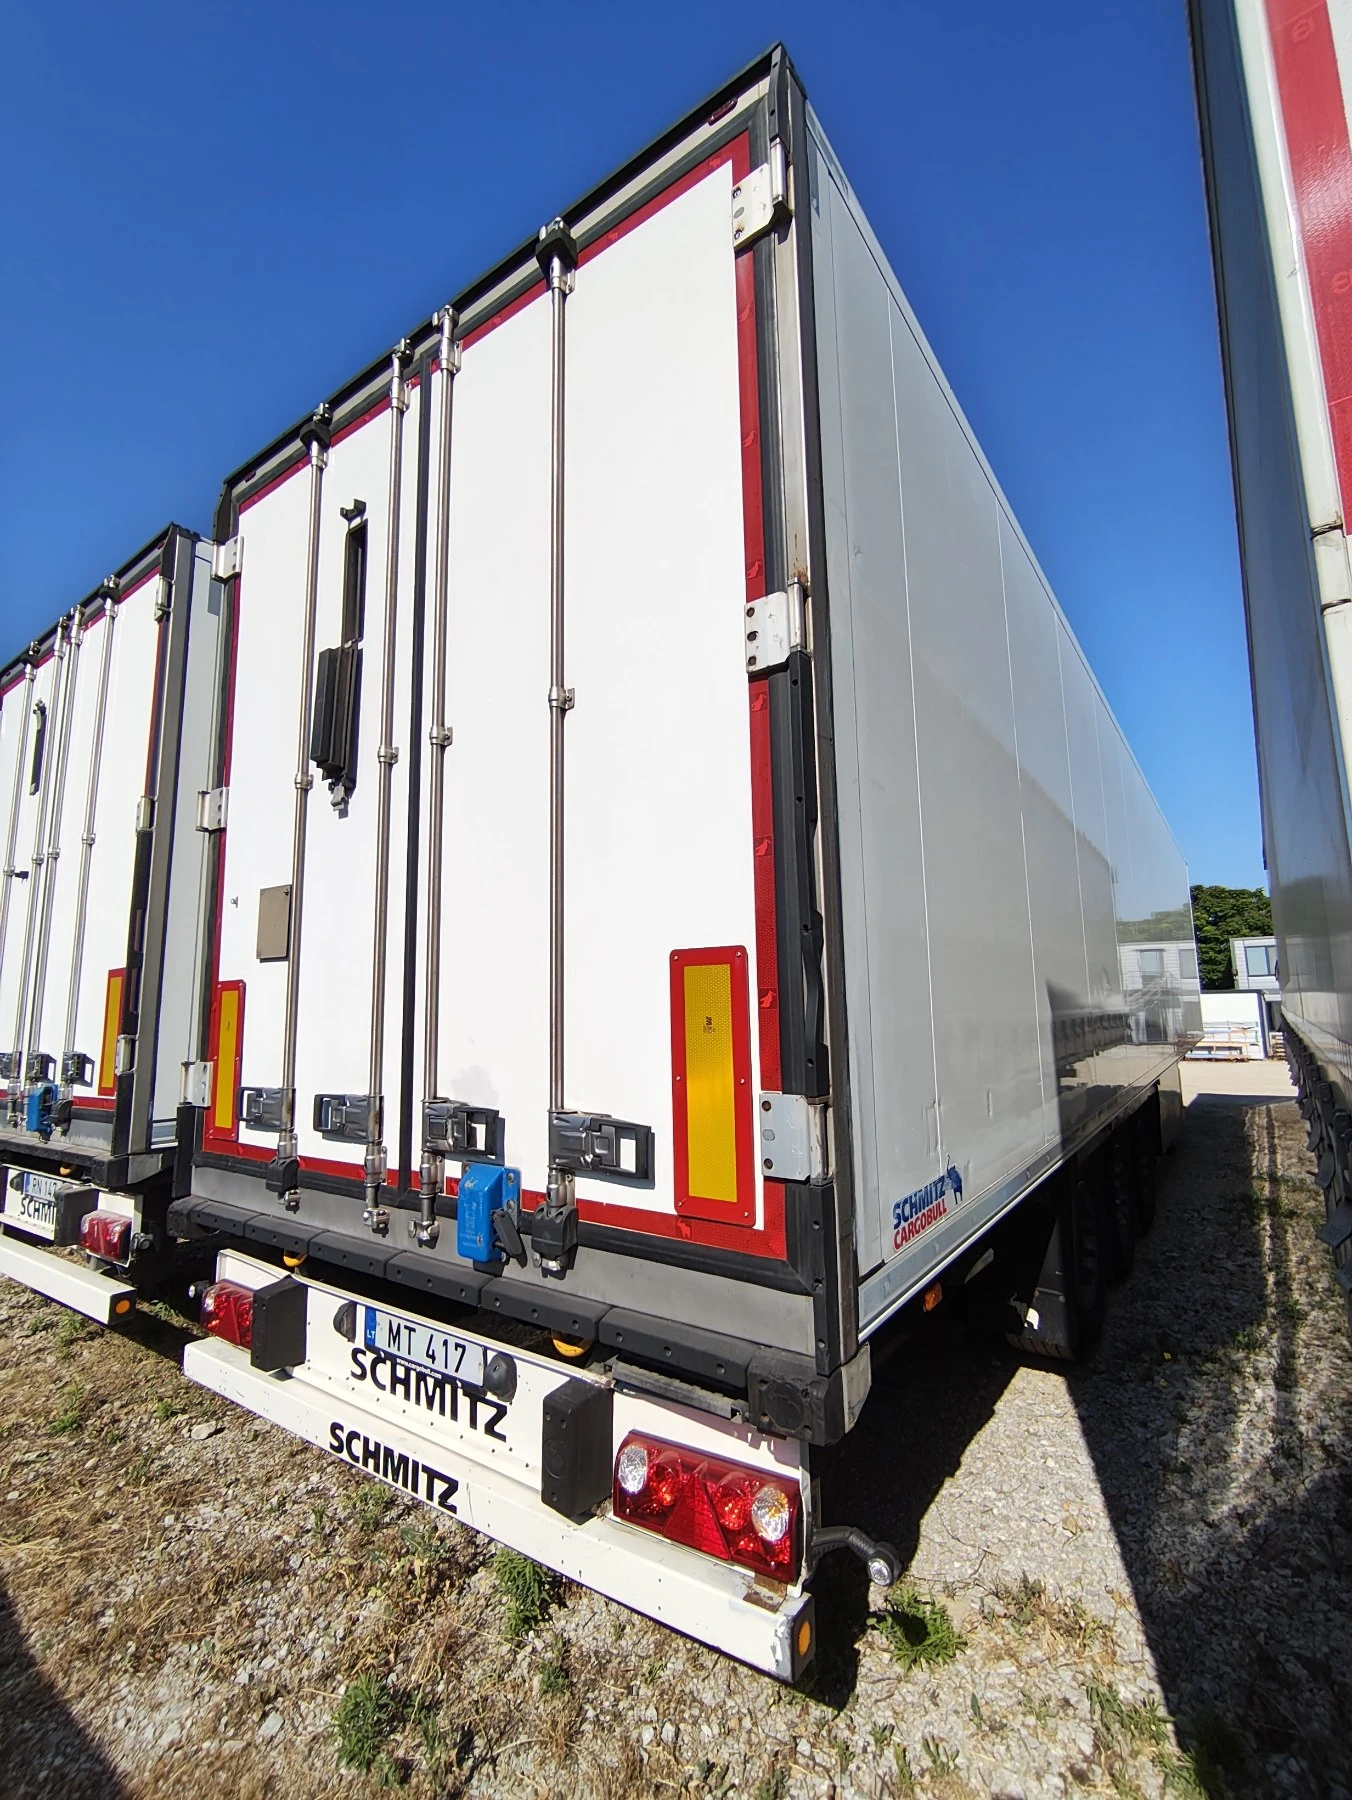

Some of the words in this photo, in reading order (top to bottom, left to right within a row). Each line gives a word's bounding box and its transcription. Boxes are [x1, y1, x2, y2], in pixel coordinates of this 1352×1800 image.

[20, 1196, 55, 1225] SCHMI
[892, 1175, 946, 1230] SCHMITZ
[894, 1198, 947, 1250] CARGOBULL
[366, 1329, 375, 1339] LT
[388, 1319, 416, 1356] MT
[425, 1333, 466, 1374] 417
[351, 1347, 508, 1443] SCHMITZ
[328, 1421, 459, 1515] SCHMITZ
